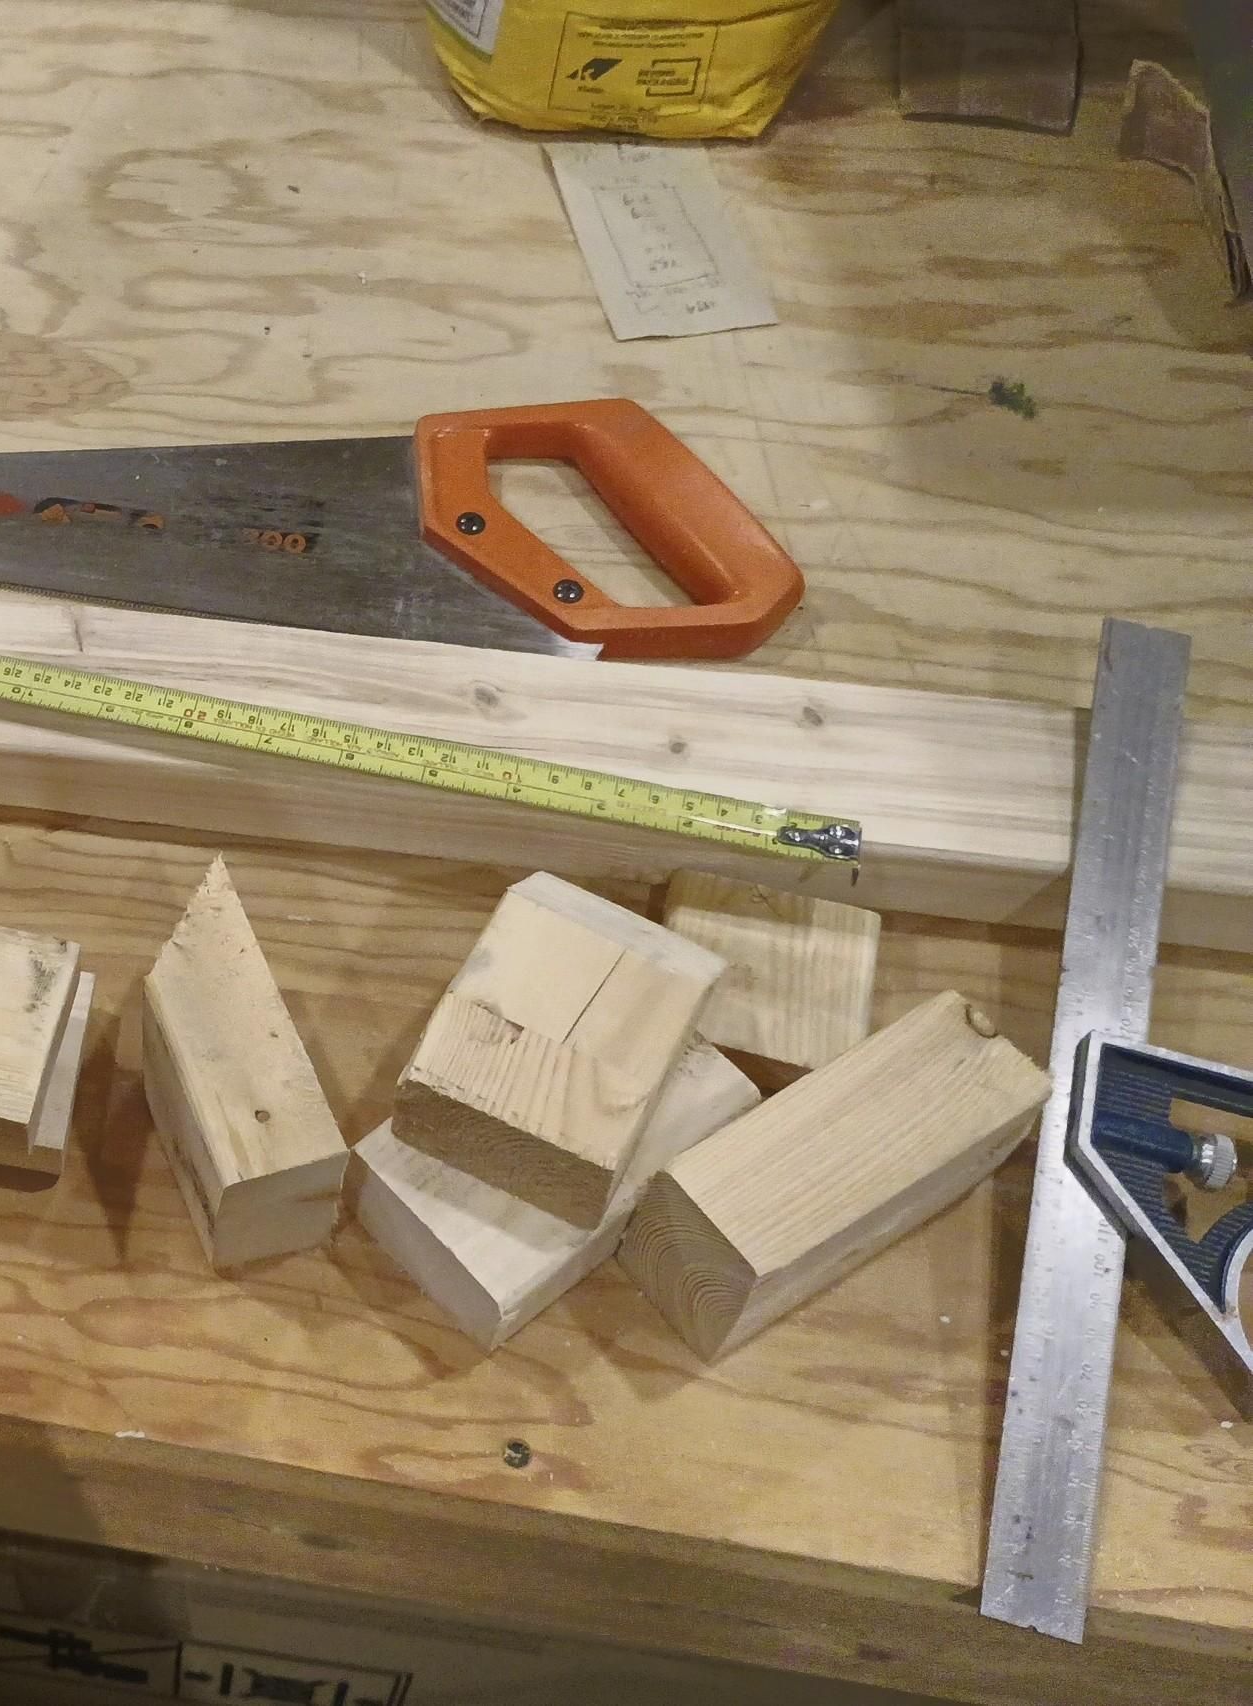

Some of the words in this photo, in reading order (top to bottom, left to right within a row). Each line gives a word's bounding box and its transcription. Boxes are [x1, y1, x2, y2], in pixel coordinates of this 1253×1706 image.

[2, 666, 22, 677] 26
[33, 673, 51, 683] 25
[63, 678, 81, 689] 24
[10, 685, 34, 696] 10
[92, 684, 112, 695] 23
[124, 690, 143, 701] 22
[157, 697, 173, 707] 21
[183, 707, 206, 720] 20
[216, 708, 232, 719] 19
[247, 714, 263, 725] 18
[279, 721, 294, 731] 17
[311, 727, 326, 737] 16
[343, 733, 358, 744] 15
[376, 740, 391, 750] 14
[408, 746, 423, 756] 13
[440, 753, 456, 763] 12
[476, 760, 489, 769] 11
